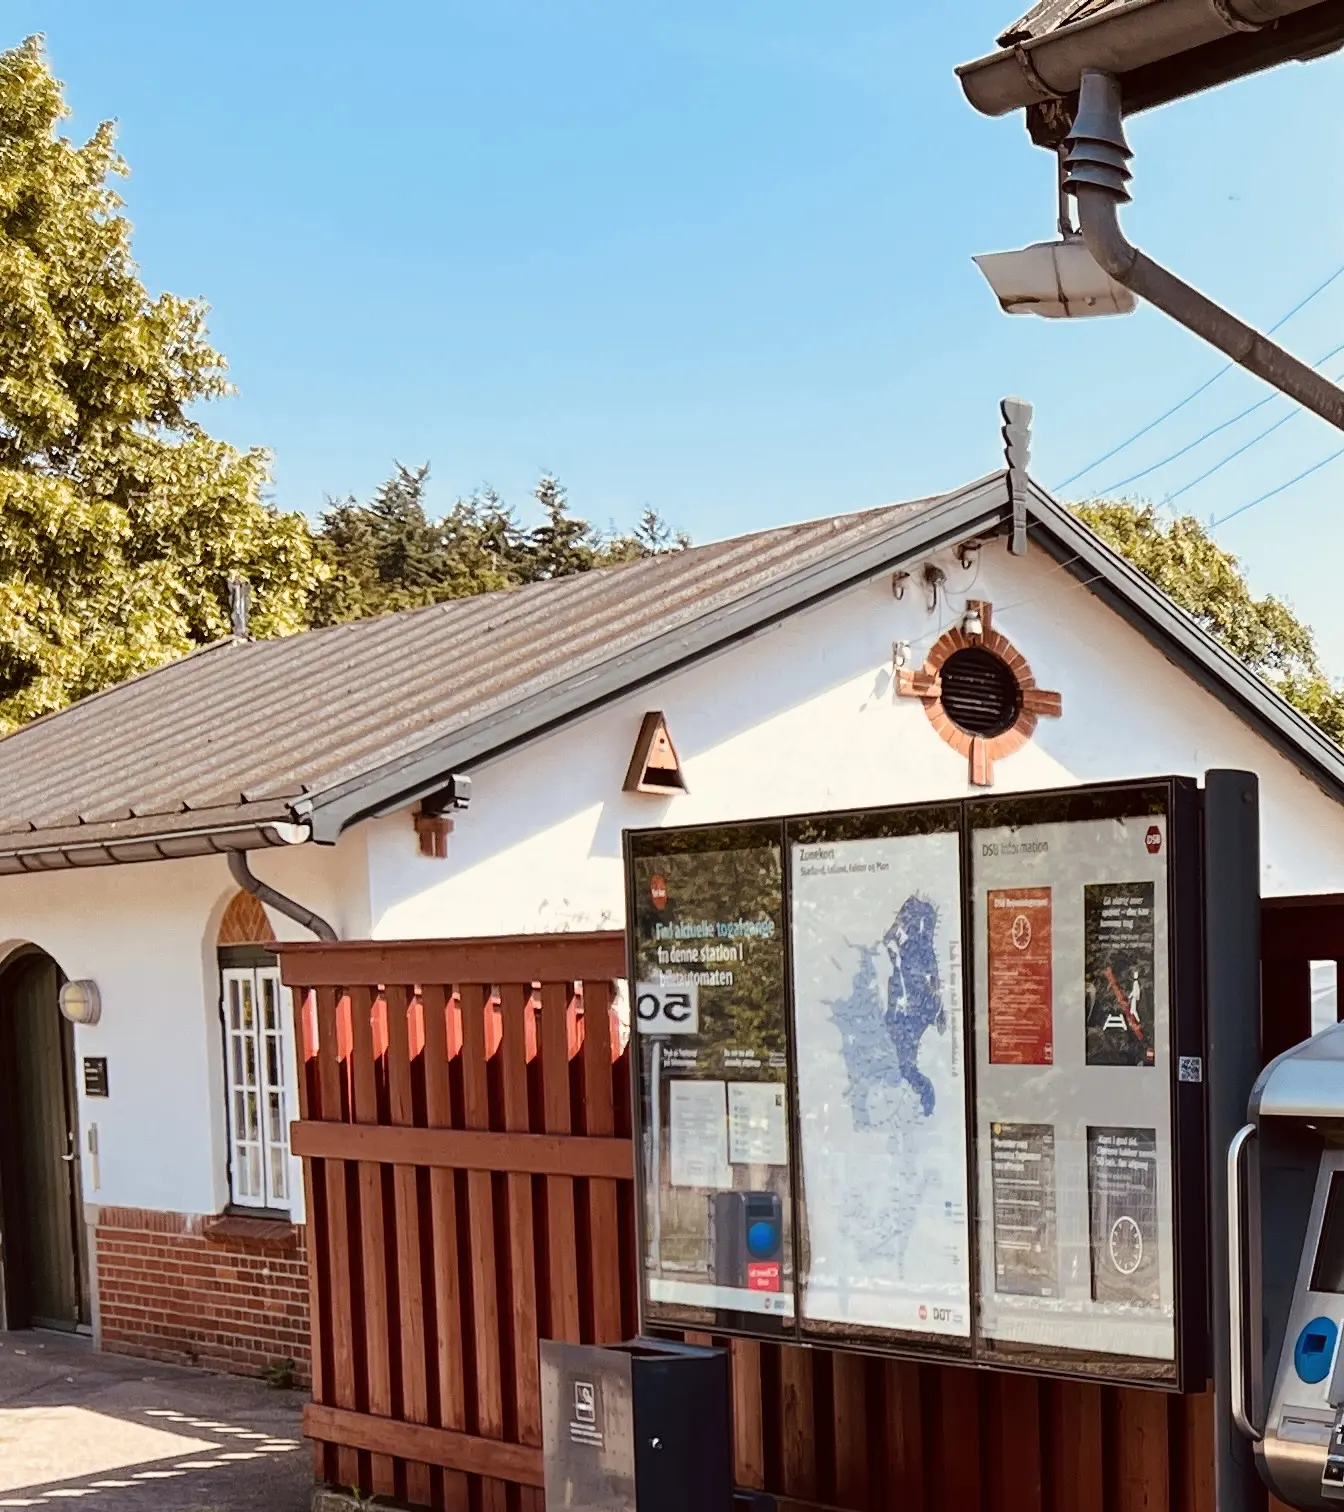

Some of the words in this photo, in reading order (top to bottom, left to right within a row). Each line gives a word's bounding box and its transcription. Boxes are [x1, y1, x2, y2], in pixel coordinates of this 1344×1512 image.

[982, 843, 999, 857] DSB
[670, 944, 699, 963] denne
[700, 942, 738, 963] station
